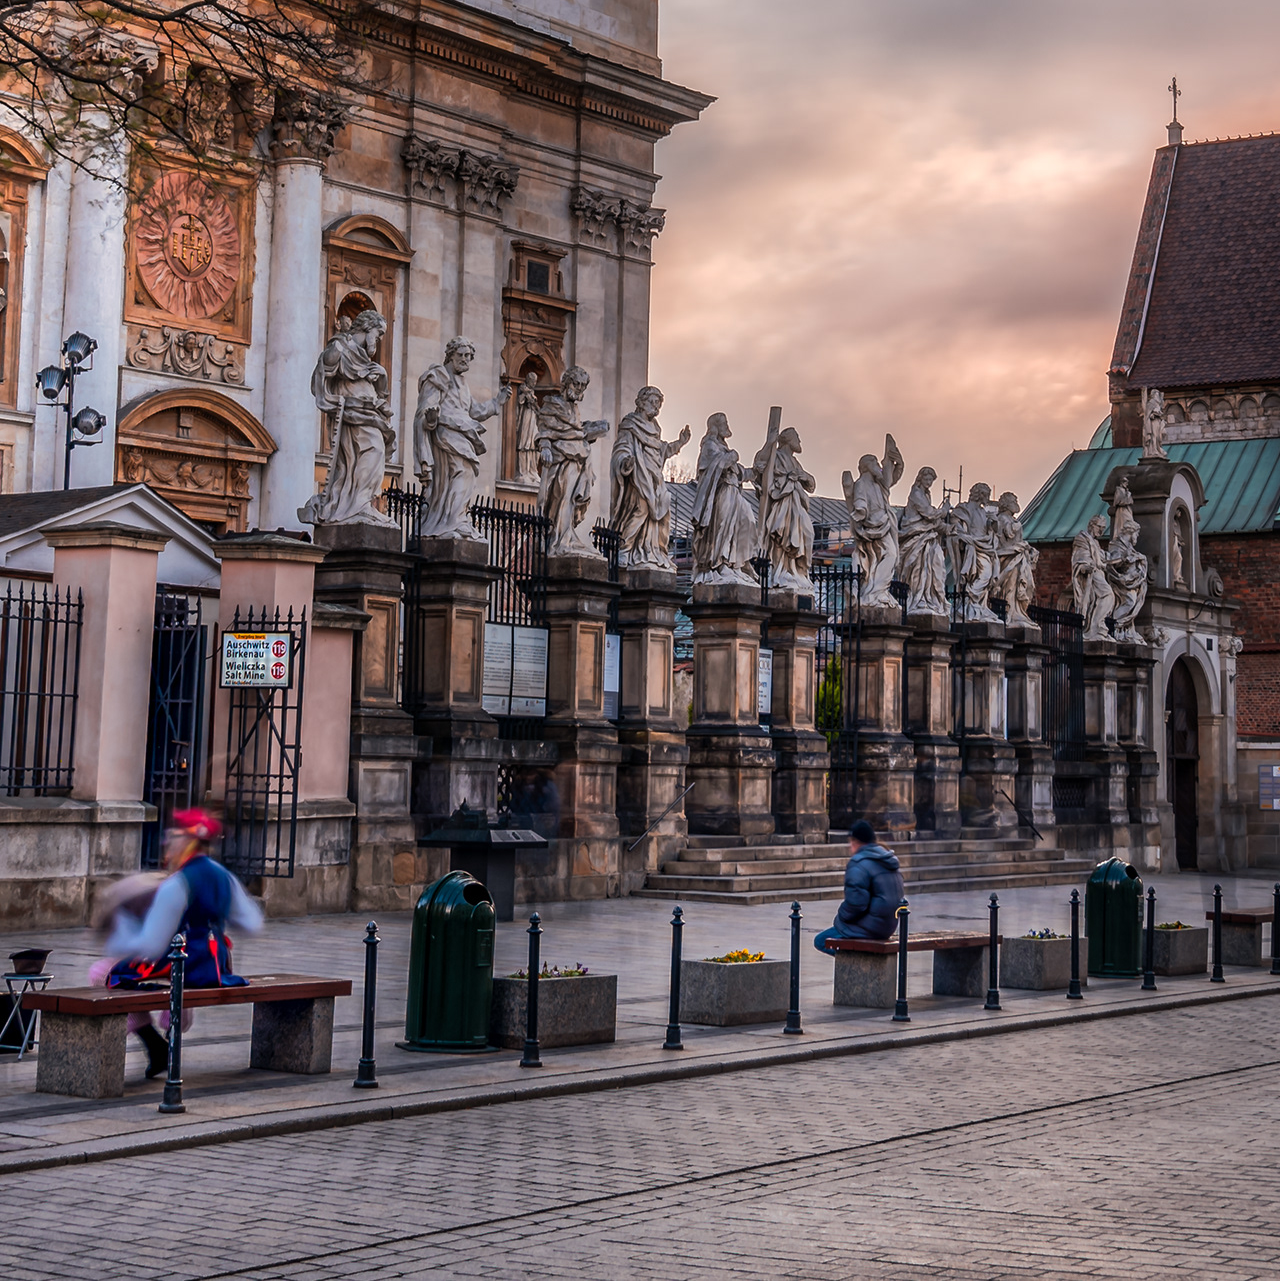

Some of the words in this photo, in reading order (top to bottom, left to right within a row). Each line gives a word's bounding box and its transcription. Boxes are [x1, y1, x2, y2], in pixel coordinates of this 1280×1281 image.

[226, 640, 270, 649] Auschwitz
[272, 644, 286, 654] 119
[226, 649, 264, 658] Birkenau
[225, 662, 266, 670] Wieliczka
[225, 671, 241, 679] Salt
[243, 671, 265, 679] Mine
[272, 666, 285, 676] 119
